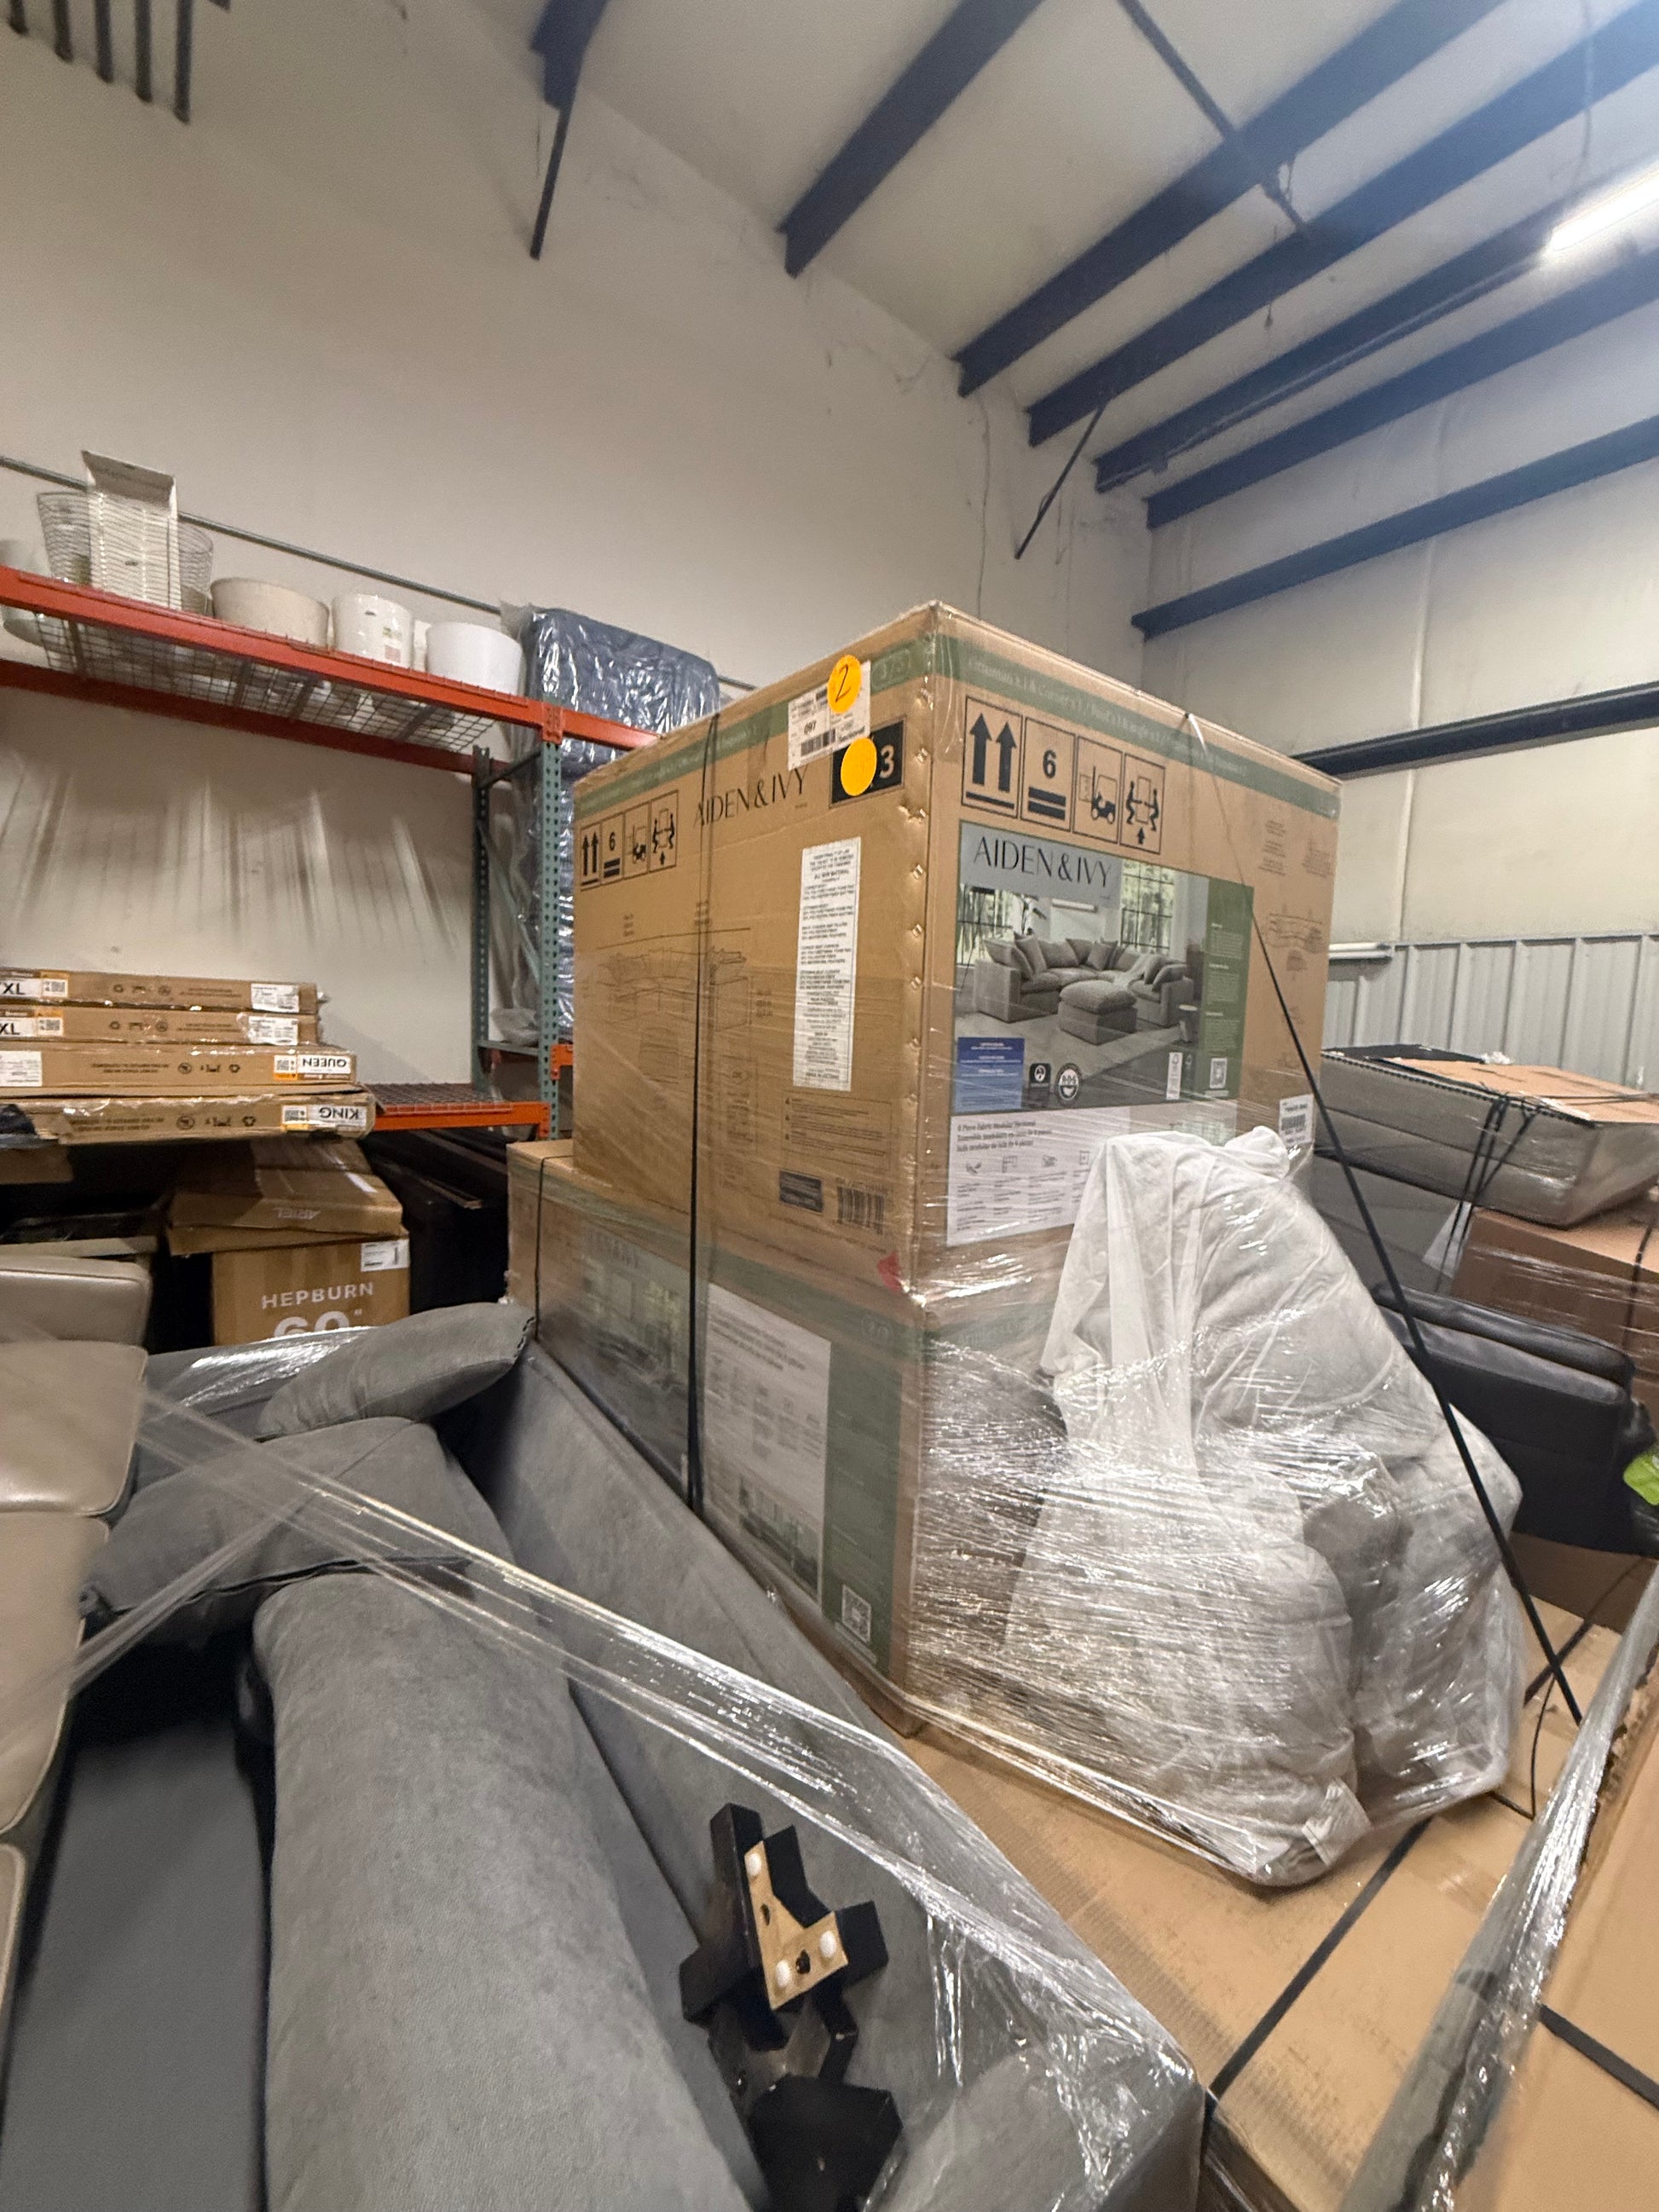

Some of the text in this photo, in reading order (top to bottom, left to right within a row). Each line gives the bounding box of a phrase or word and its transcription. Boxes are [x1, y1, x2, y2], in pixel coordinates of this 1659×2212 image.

[835, 663, 852, 702] 2
[1043, 750, 1056, 779] 6
[609, 831, 616, 852] 6
[303, 1058, 347, 1068] QUEEN
[319, 1106, 359, 1120] KING
[262, 1281, 374, 1309] HEPBURN
